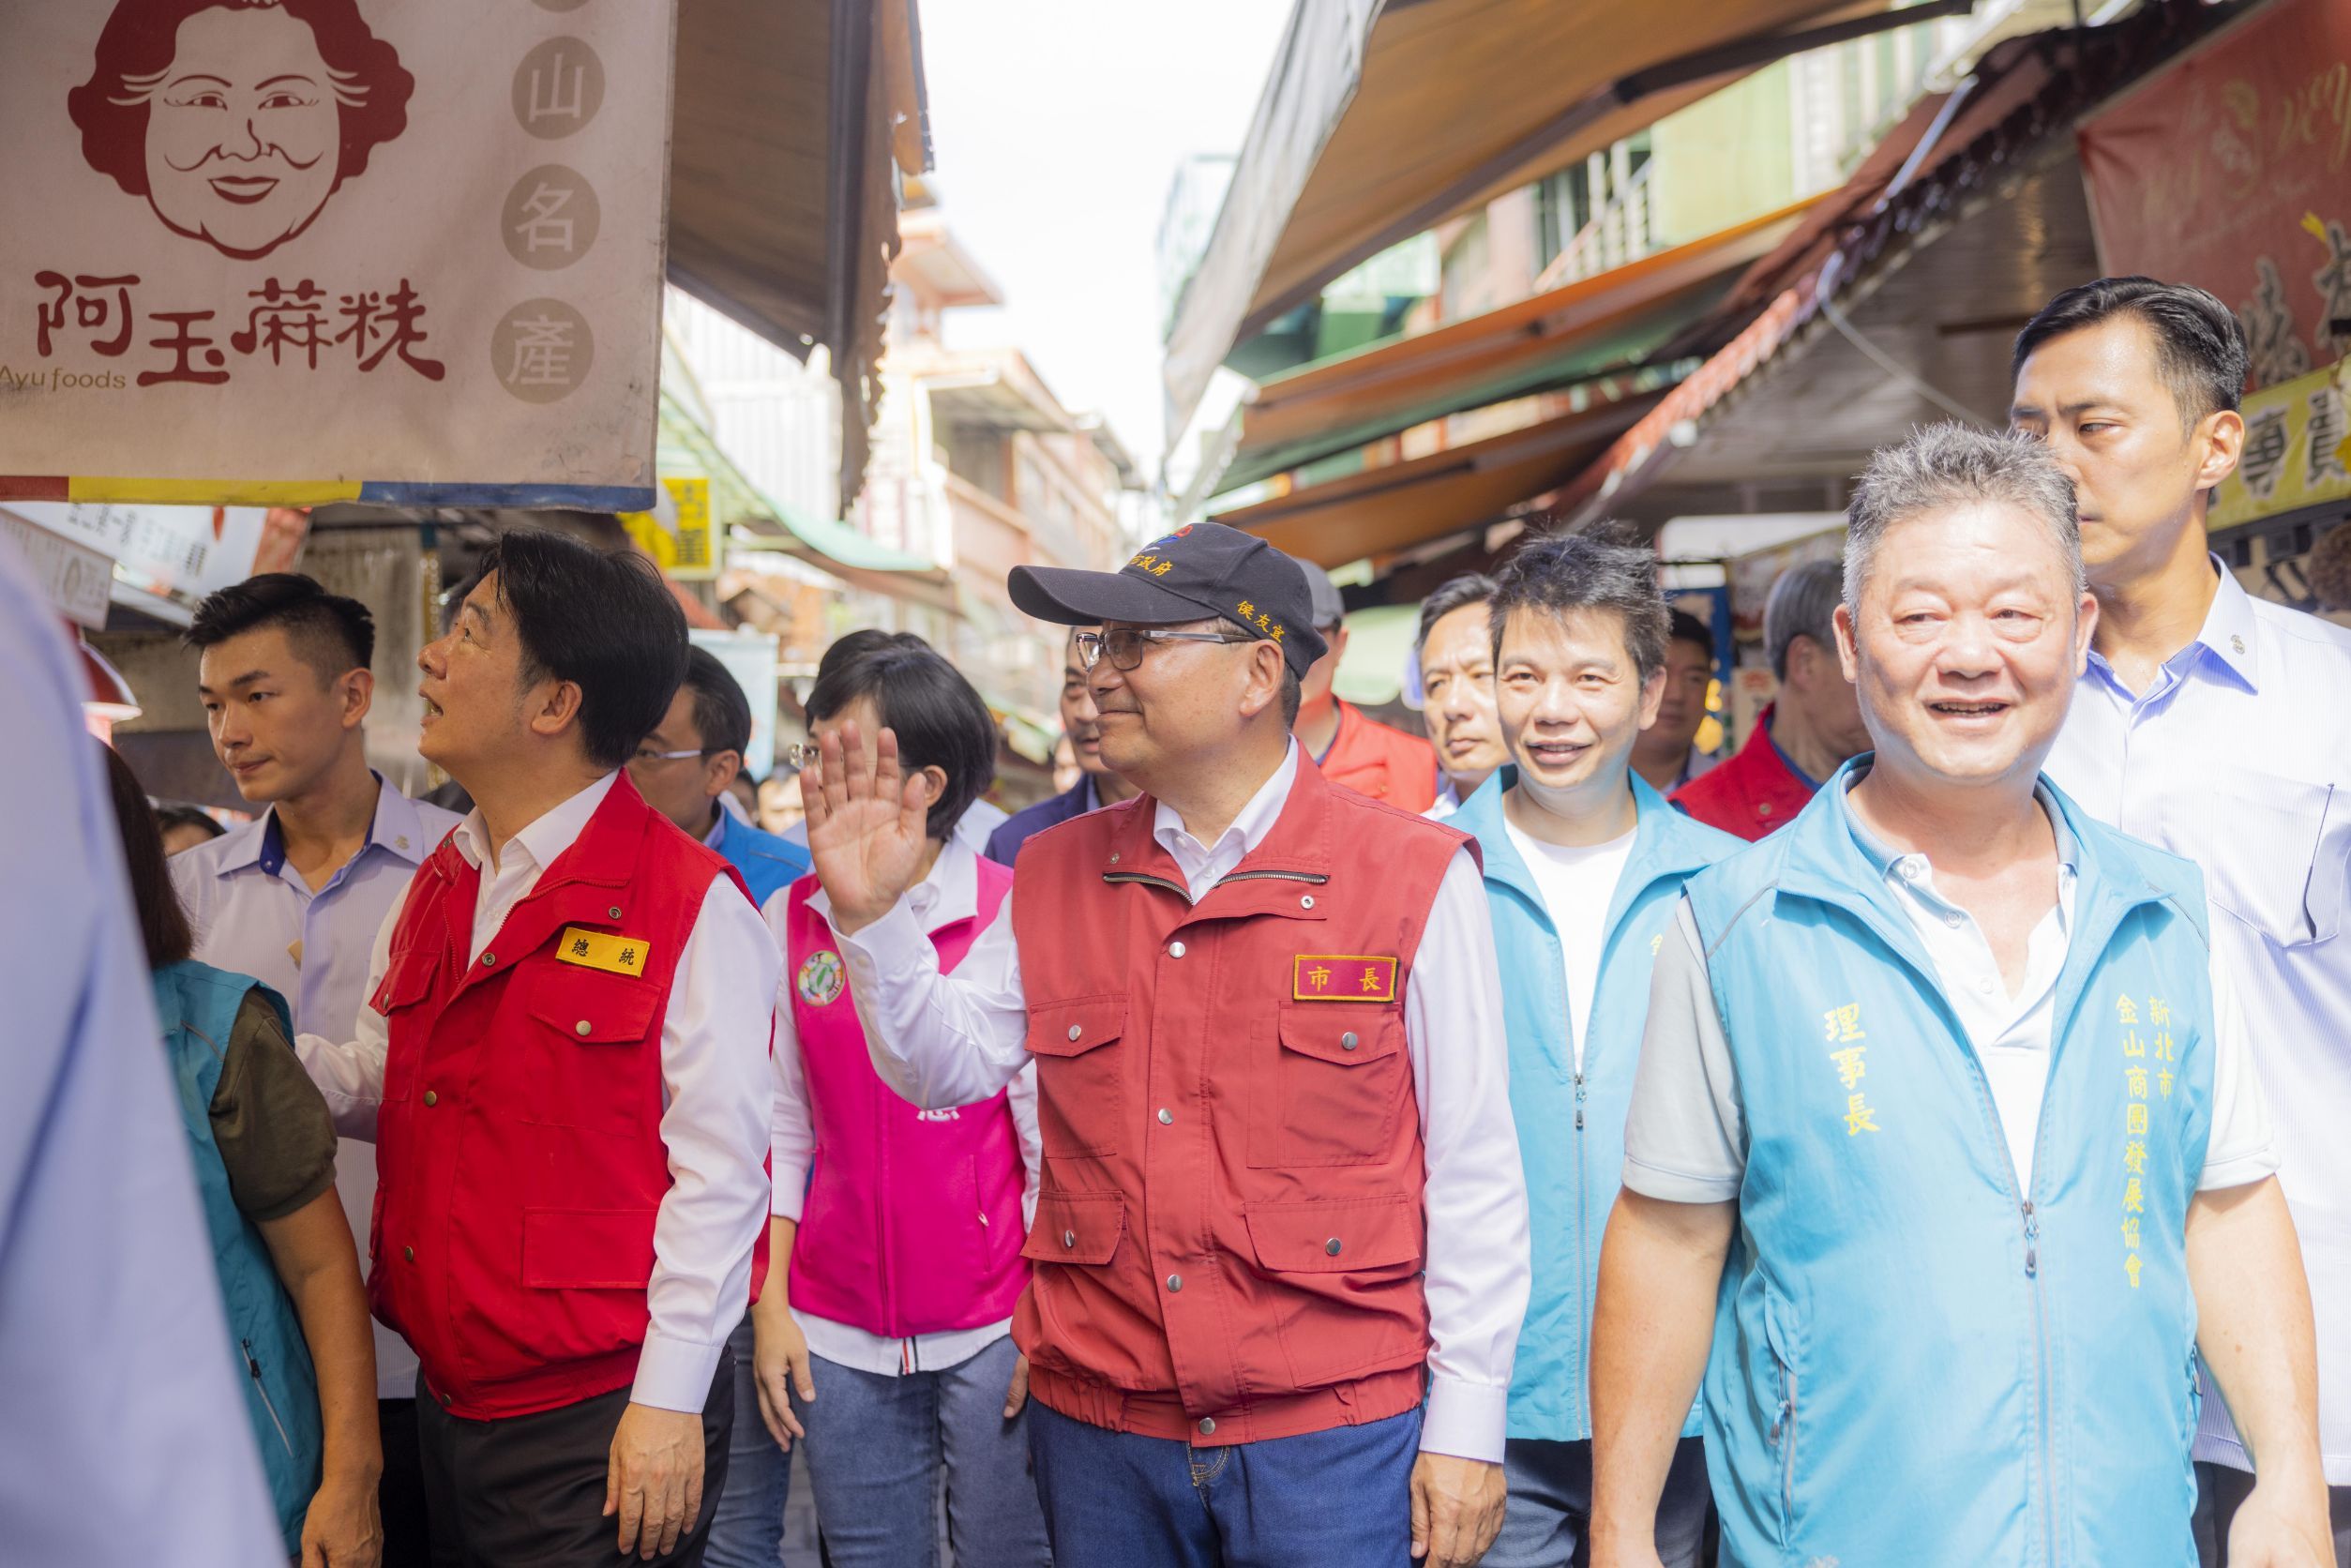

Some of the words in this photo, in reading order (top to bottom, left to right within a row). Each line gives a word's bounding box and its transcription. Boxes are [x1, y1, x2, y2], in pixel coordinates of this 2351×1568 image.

[0, 365, 46, 391] Ayu
[52, 367, 127, 392] foods
[1237, 600, 1285, 643] 侯友宜
[571, 938, 635, 966] 總統
[1307, 965, 1382, 992] 市長
[1824, 1003, 1881, 1138] 理事長
[2148, 995, 2175, 1103] 新北市
[2116, 992, 2149, 1289] 金山商圈發展協會
